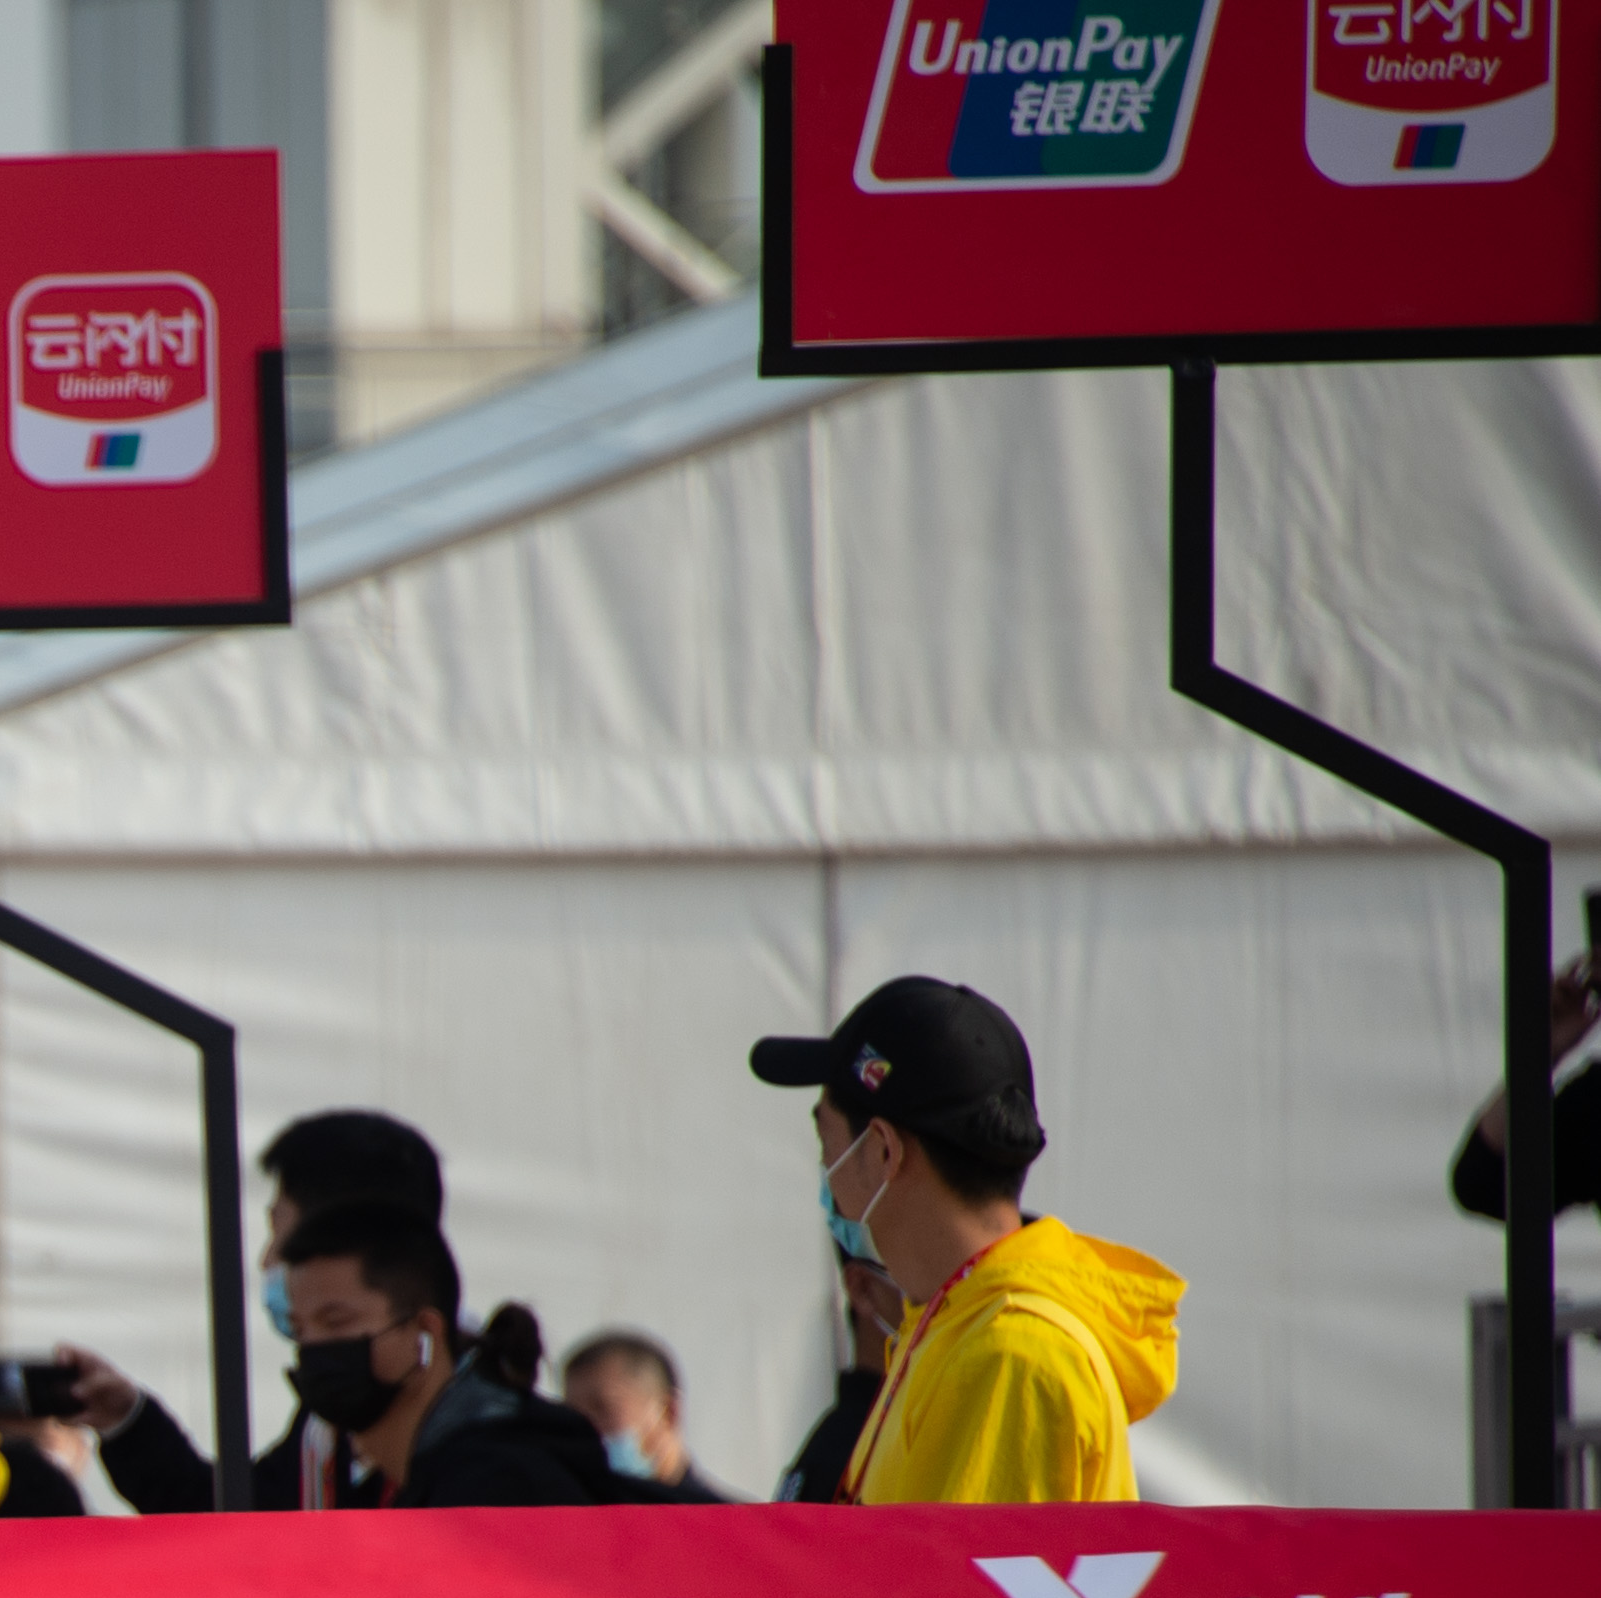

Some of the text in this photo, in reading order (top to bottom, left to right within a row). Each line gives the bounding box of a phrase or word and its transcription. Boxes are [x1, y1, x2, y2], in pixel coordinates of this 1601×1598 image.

[909, 14, 1184, 89] UnionPay
[1364, 51, 1502, 86] UnionPay
[1009, 80, 1157, 136] 银联
[25, 308, 202, 368] 云闪付
[56, 371, 174, 402] UnionPay
